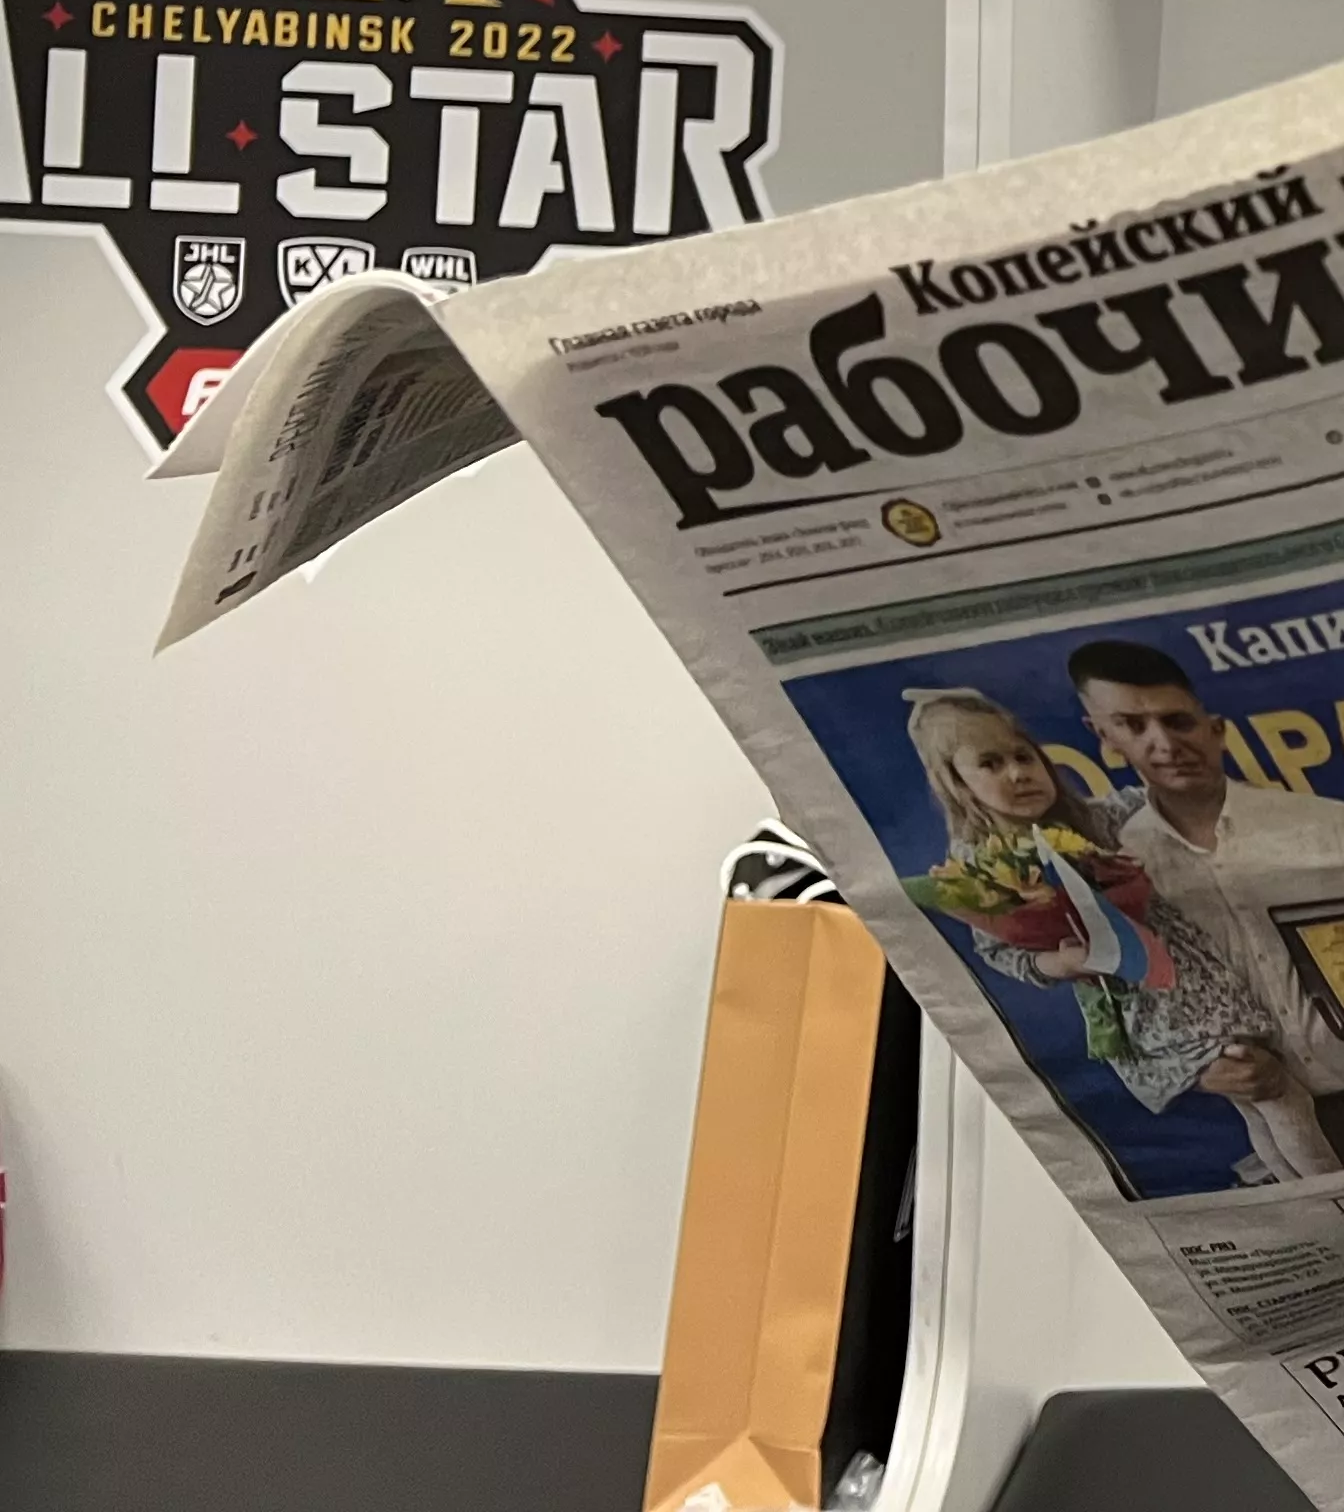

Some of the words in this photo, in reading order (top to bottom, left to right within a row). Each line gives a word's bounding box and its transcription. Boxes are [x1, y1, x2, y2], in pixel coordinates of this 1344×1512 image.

[92, 1, 414, 54] CHELYABINSK
[449, 19, 576, 62] 2022
[277, 30, 765, 234] STAR
[184, 243, 235, 263] JHL
[410, 256, 469, 280] WHL
[889, 163, 1323, 316] Копейский
